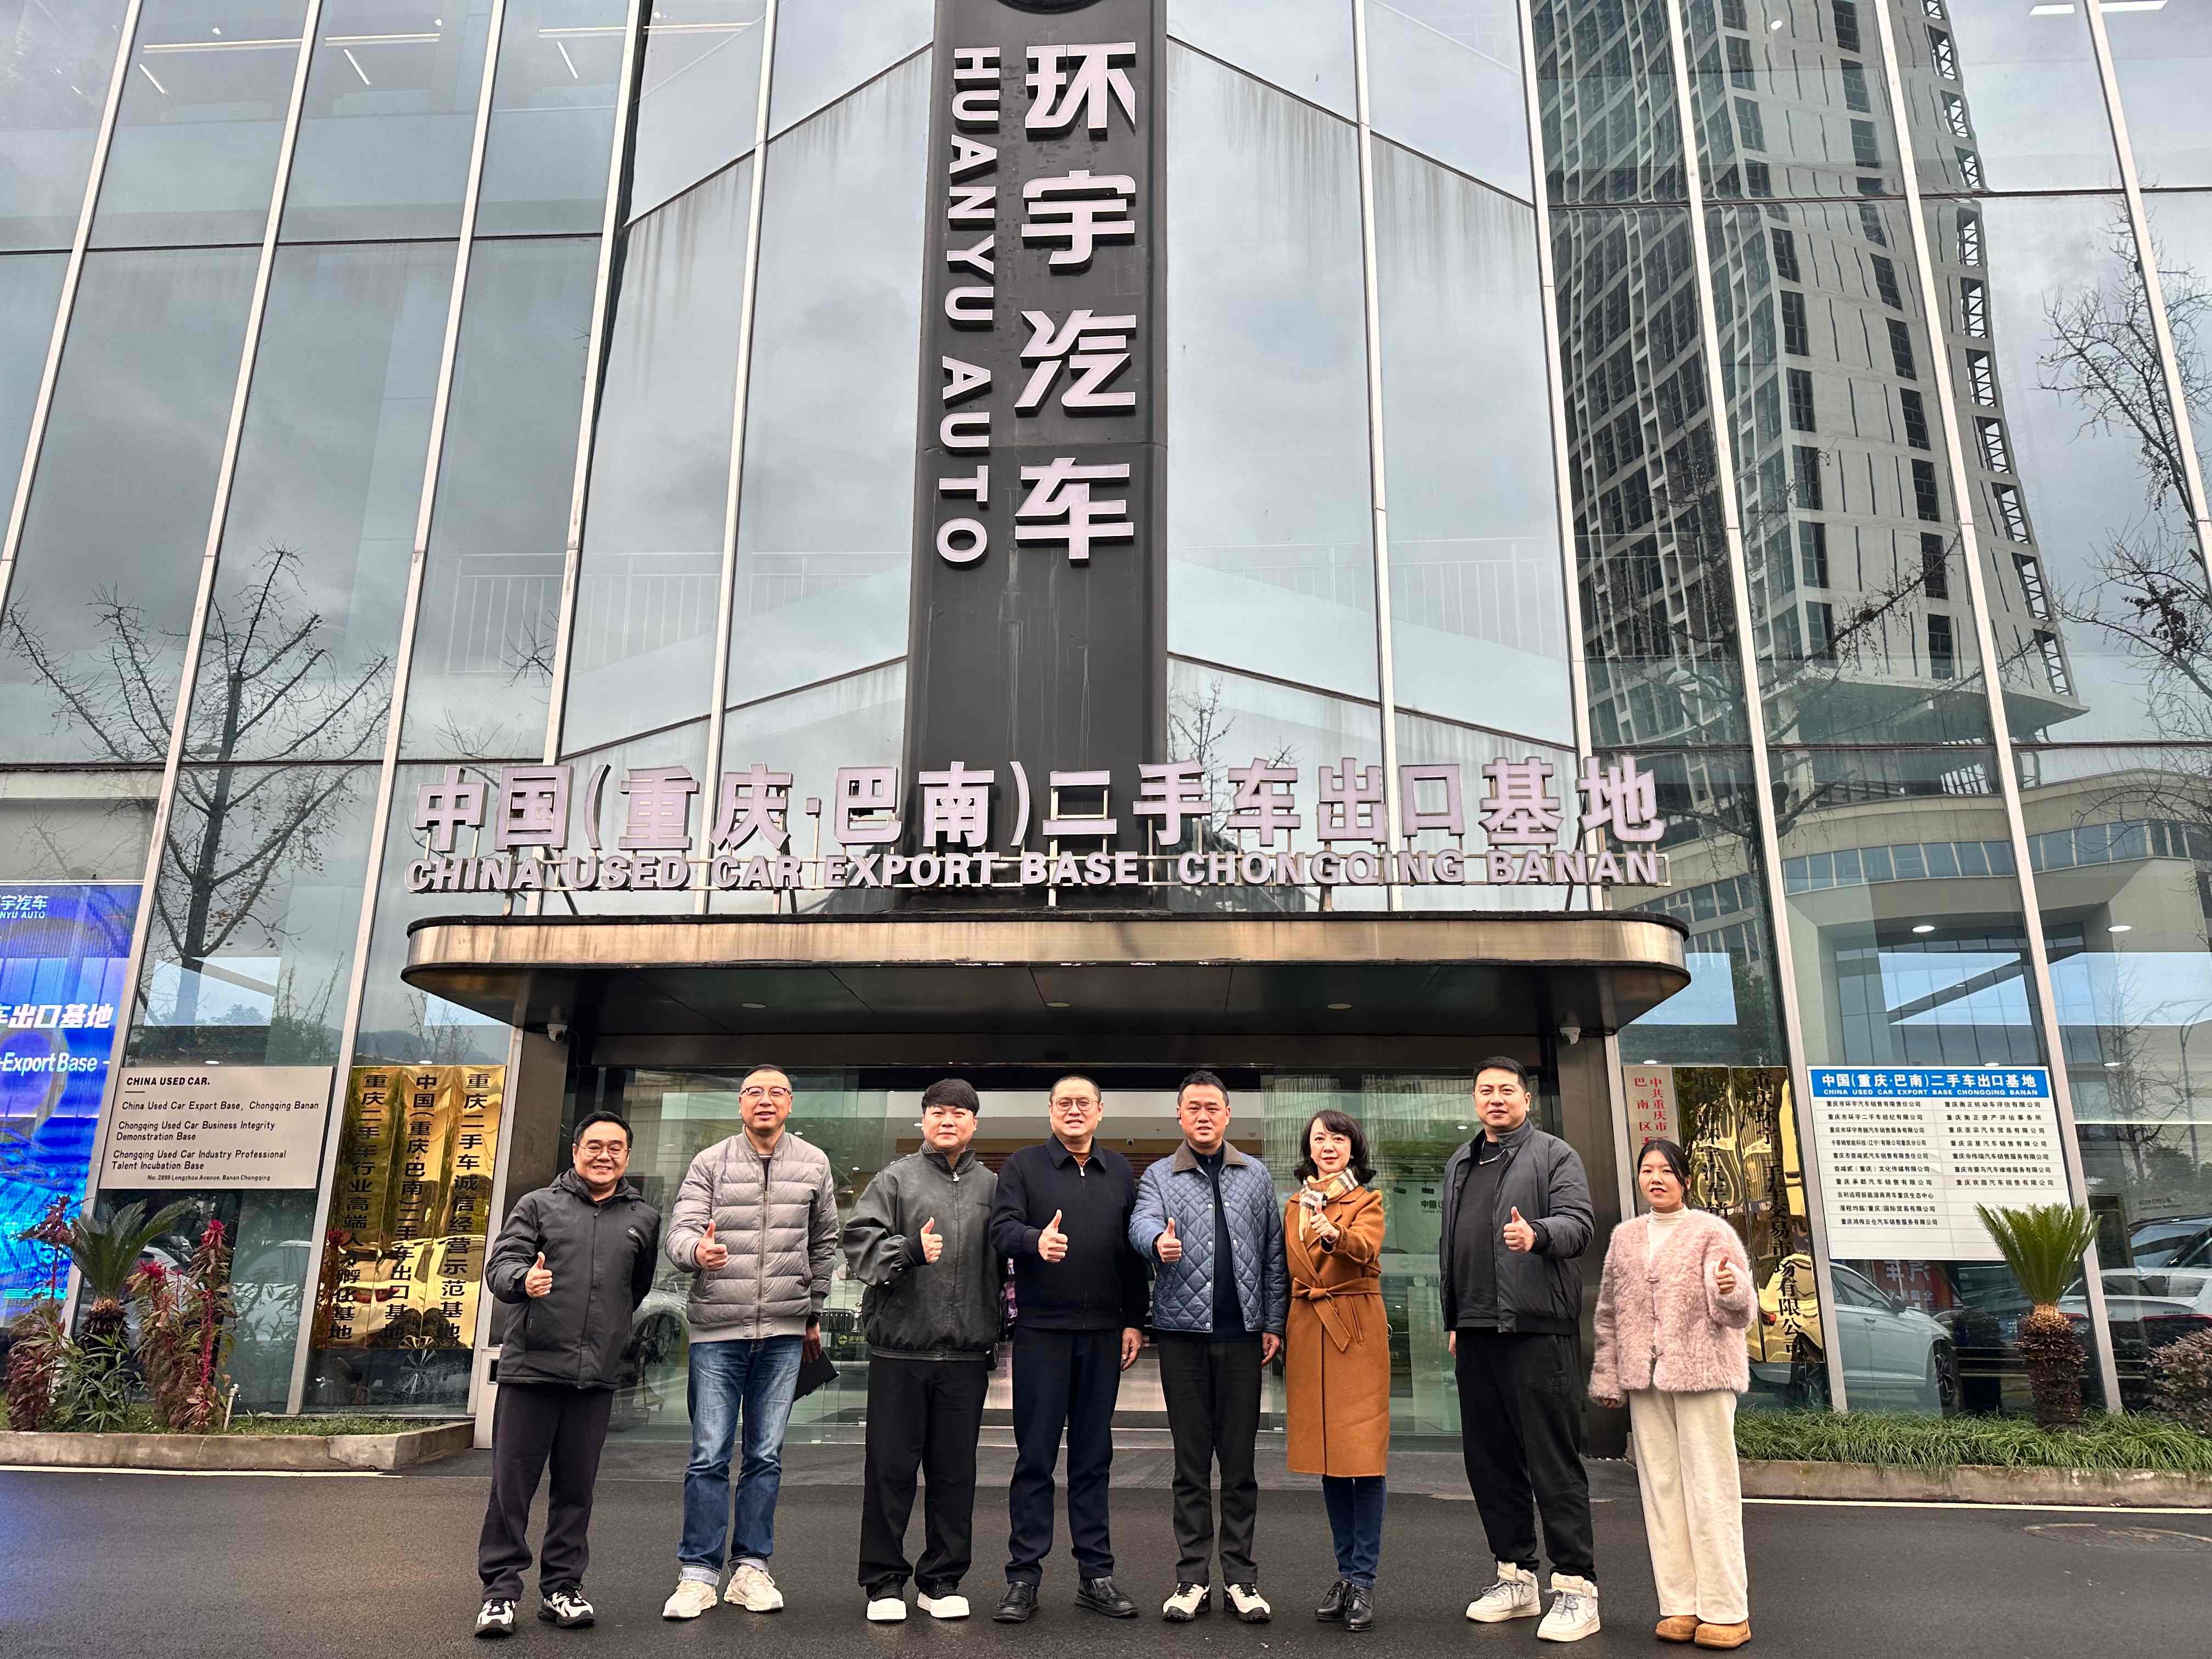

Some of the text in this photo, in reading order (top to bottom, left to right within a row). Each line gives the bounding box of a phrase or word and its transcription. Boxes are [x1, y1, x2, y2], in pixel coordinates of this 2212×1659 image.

[936, 46, 1001, 569] HUANYU AUTO
[1013, 41, 1137, 561] 环宇汽车
[404, 849, 1658, 891] CHINA USED CAR EXPORT BASE CHONGQING BANAN
[0, 895, 48, 911] 宇汽车
[57, 1052, 98, 1072] Base
[126, 1077, 211, 1086] CHINA USED CAR.
[1822, 1073, 2036, 1088] 中国(重庆·巴南)二手车出口基地
[122, 1101, 144, 1110] China
[148, 1101, 167, 1110] Used
[171, 1102, 185, 1110] Car
[189, 1102, 217, 1111] Export
[249, 1101, 291, 1111] Chongqing
[294, 1101, 319, 1109] Banan
[1650, 1077, 1668, 1141] 中共重庆市
[118, 1121, 275, 1131] Chongqing Used Car Business Integrity
[116, 1132, 196, 1141] Demonstration Base
[113, 1149, 286, 1160] Chongqing Used Car Industry Professional
[111, 1161, 204, 1170] Talent Incubation Base
[329, 1074, 388, 1340] 重庆二手车行业高端人才孵化基地
[439, 1074, 491, 1340] 重庆二手车诚信经营示范基地
